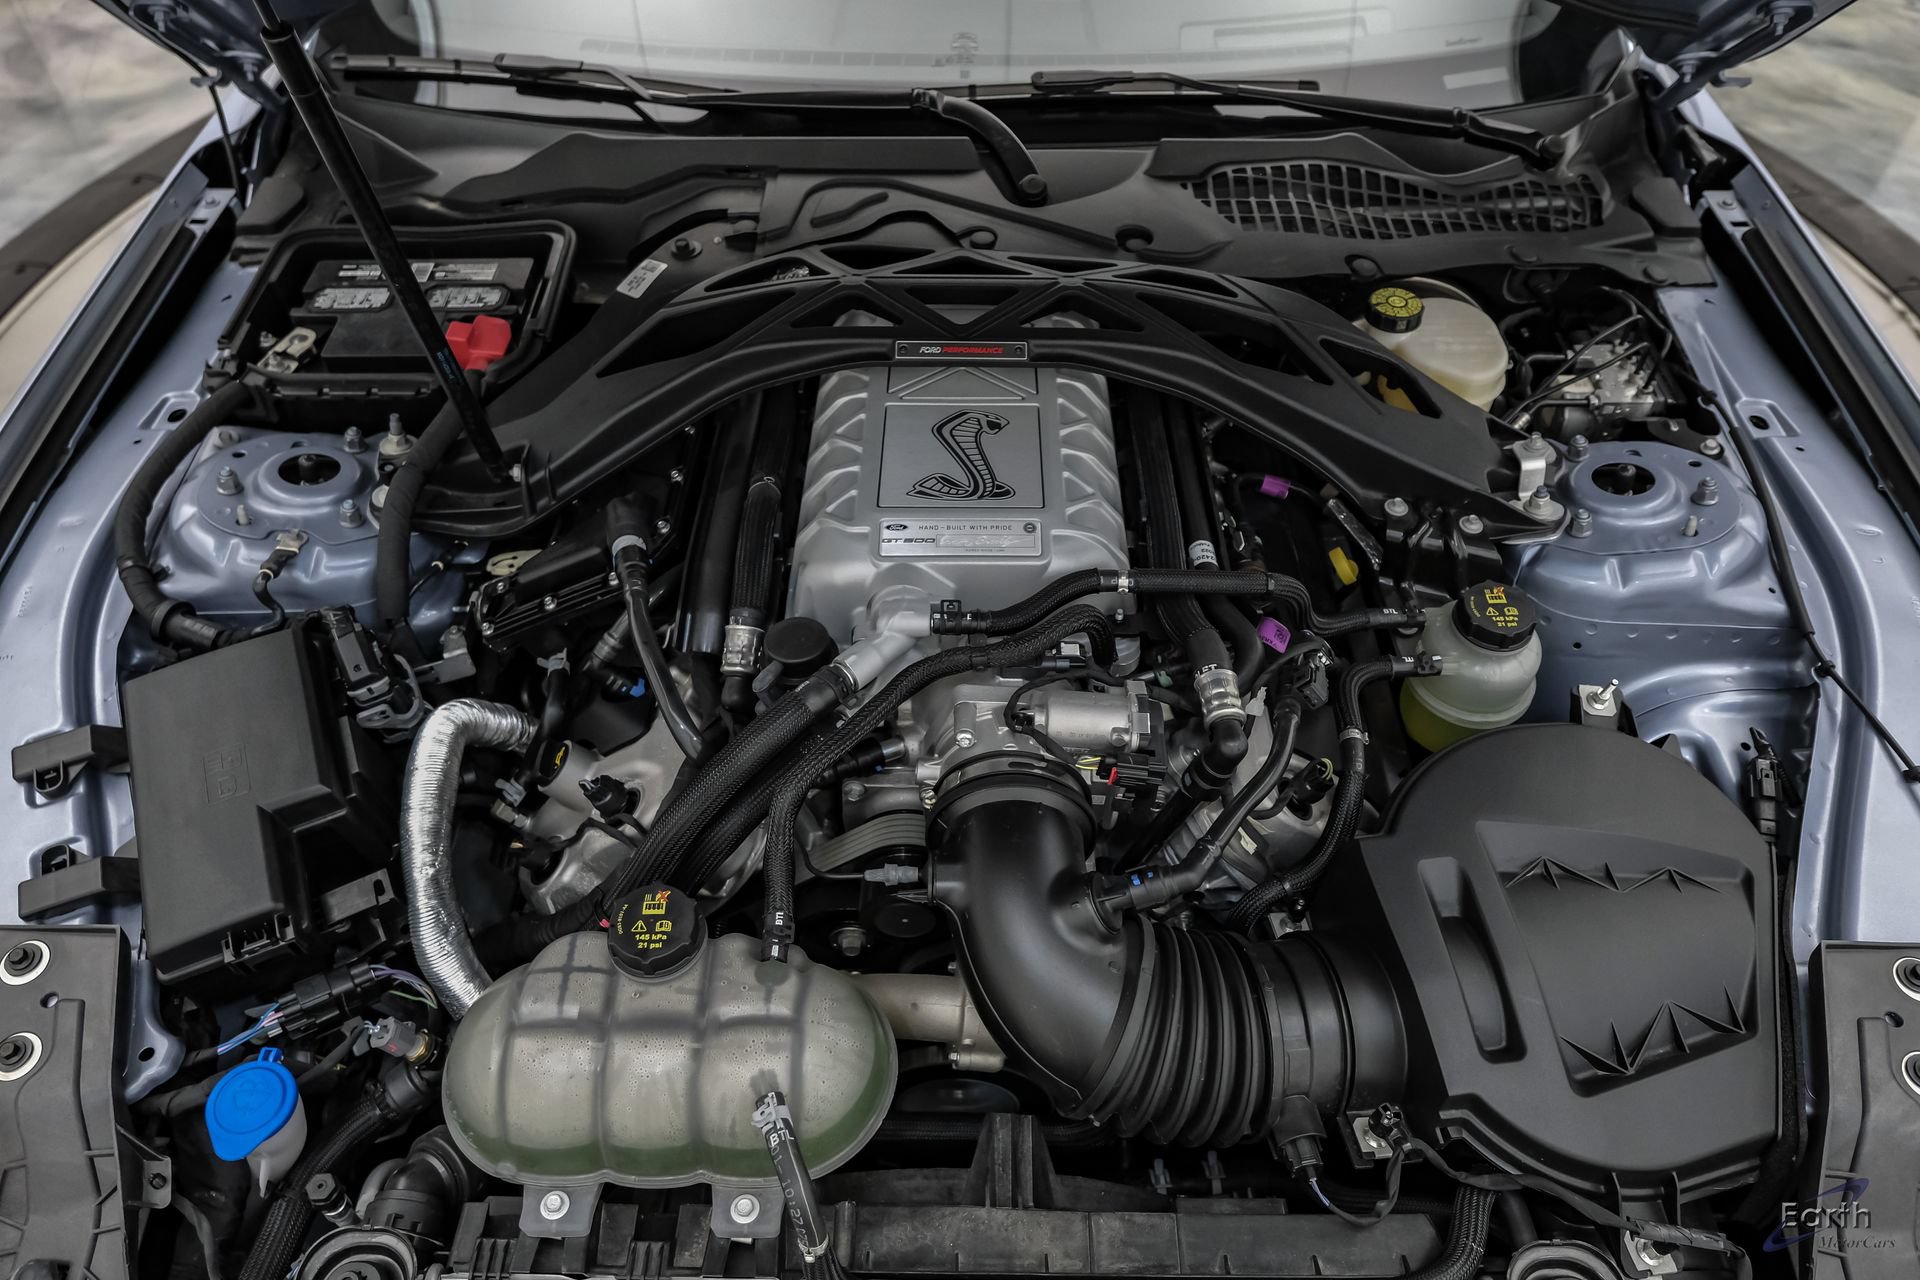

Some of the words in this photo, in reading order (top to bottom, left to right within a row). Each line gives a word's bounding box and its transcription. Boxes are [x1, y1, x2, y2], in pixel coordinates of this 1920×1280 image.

[919, 346, 942, 354] FORD
[942, 346, 1004, 354] PERFORMANCE
[651, 933, 667, 941] kPa
[649, 942, 662, 950] psi
[769, 1128, 795, 1148] BTL
